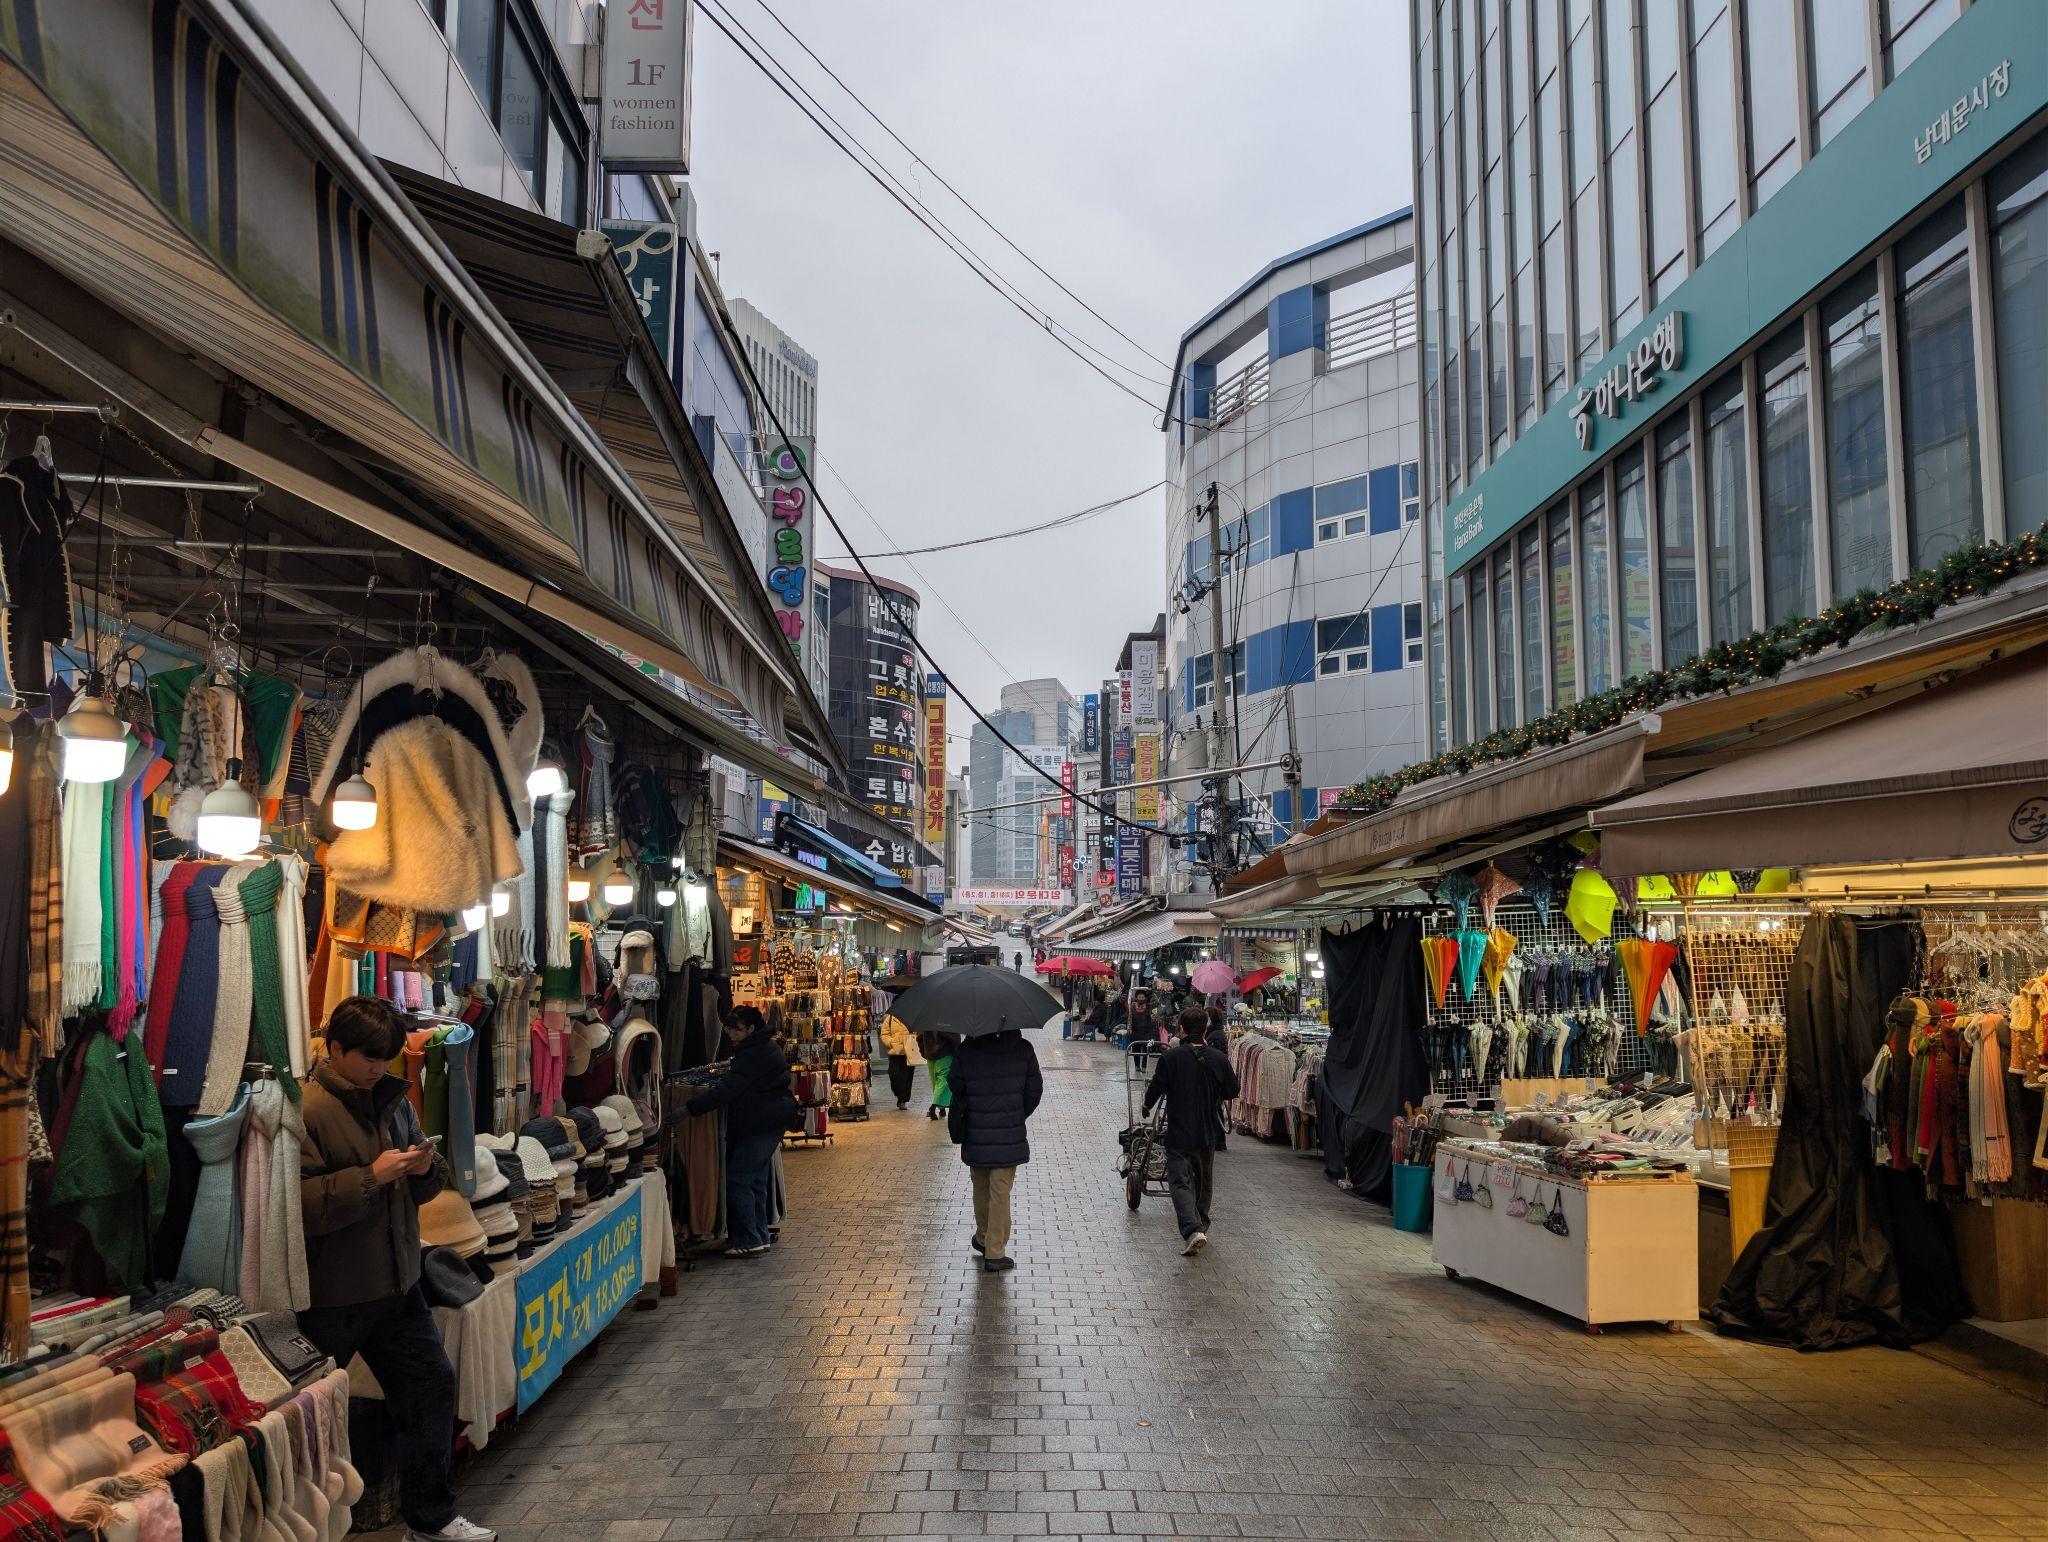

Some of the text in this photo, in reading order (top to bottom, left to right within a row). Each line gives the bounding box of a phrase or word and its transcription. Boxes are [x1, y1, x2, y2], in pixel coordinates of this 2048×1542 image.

[626, 58, 666, 86] 1F
[610, 115, 676, 130] fashion
[612, 98, 676, 110] women
[1914, 59, 2012, 165] 남대문시장
[1595, 310, 1684, 419] 하나은행
[1120, 679, 1132, 714] 부동산
[1086, 711, 1095, 746] 우리은행
[928, 704, 944, 832] 그릇도매상가
[1120, 837, 1141, 891] 그릇도매
[519, 1266, 571, 1381] 모자
